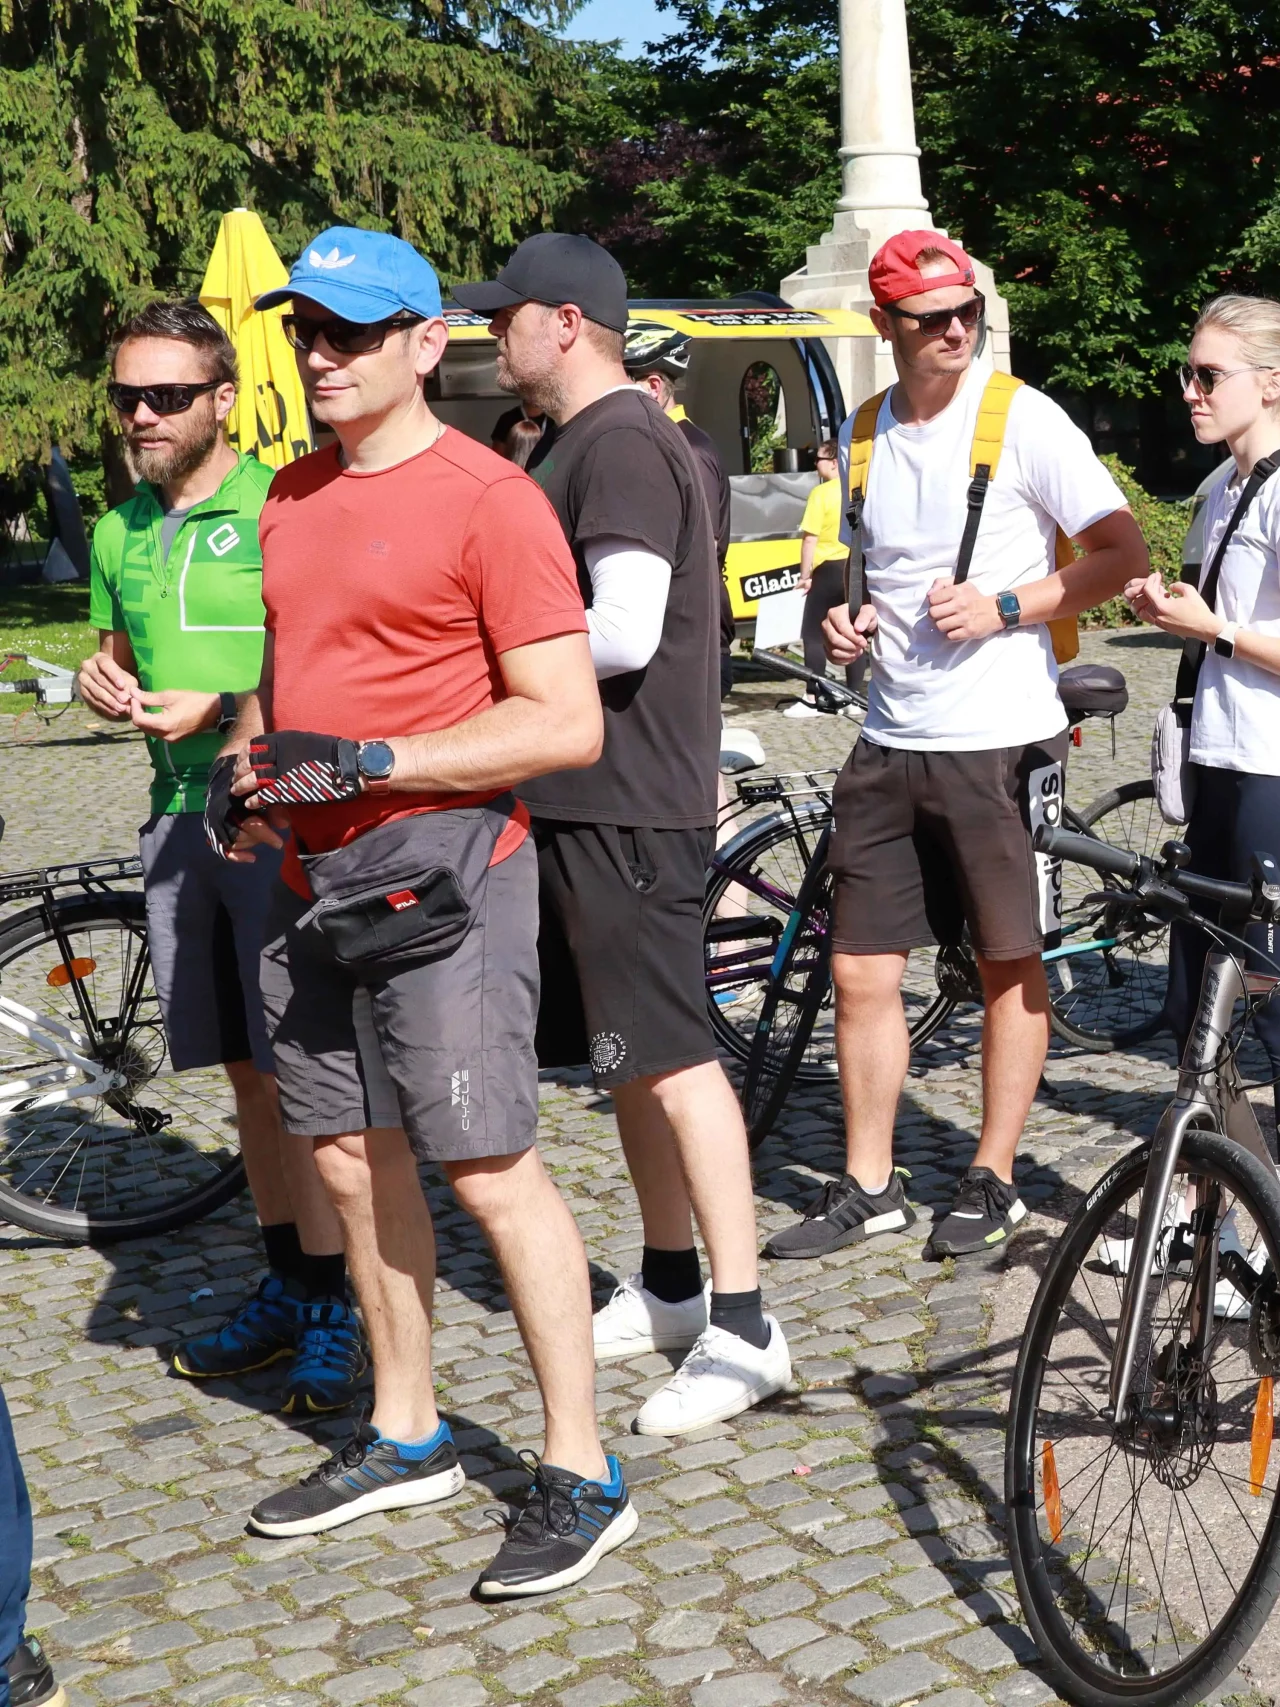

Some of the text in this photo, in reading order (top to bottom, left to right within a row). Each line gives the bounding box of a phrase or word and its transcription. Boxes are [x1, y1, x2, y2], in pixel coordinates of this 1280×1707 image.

[395, 899, 416, 910] FILA
[461, 1069, 470, 1131] CYCLE
[1086, 1174, 1112, 1211] GIANT
